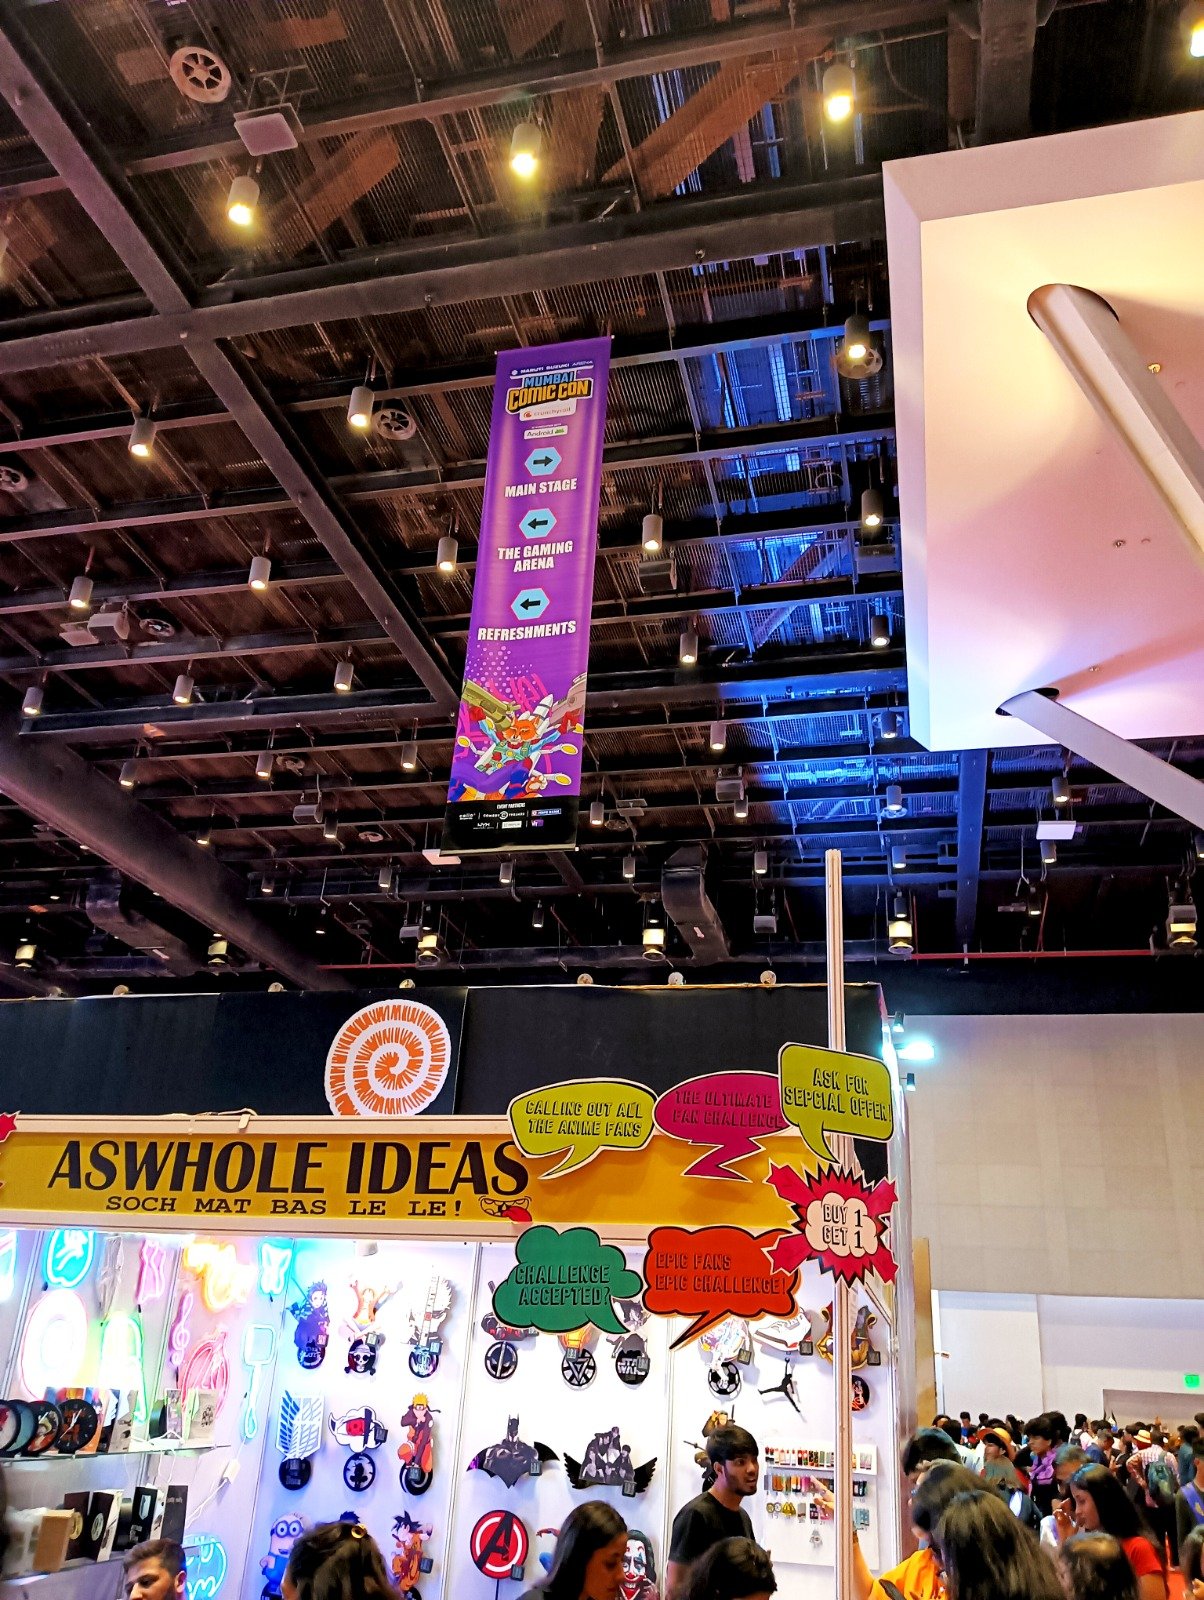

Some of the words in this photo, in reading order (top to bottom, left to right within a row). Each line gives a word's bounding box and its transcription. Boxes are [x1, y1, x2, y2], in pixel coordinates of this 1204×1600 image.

[524, 371, 575, 388] MUMBAI
[508, 384, 557, 411] COMIC
[557, 380, 591, 400] CON
[526, 429, 554, 438] Android
[504, 481, 537, 498] MAIN
[538, 478, 578, 494] STAGE
[497, 546, 521, 560] THE
[523, 541, 573, 558] GAMING
[513, 556, 555, 572] ARENA
[477, 620, 577, 641] REFRESHMENTS
[812, 1068, 840, 1089] ASK
[845, 1074, 869, 1096] FOR
[674, 1090, 700, 1105] THE
[704, 1091, 773, 1108] ULTIMATE
[784, 1086, 846, 1114] SEPCIAL
[850, 1097, 893, 1122] OFFER!
[525, 1100, 583, 1116] CALLING
[586, 1102, 613, 1117] OUT
[616, 1103, 644, 1119] ALL
[672, 1110, 700, 1124] FAN
[703, 1111, 784, 1129] CHALLENGE
[528, 1118, 554, 1134] THE
[558, 1120, 601, 1136] ANIME
[605, 1121, 642, 1138] FANS
[47, 1140, 328, 1195] ASWHOLE
[345, 1141, 529, 1196] IDEAS
[106, 1196, 177, 1212] SOCH
[193, 1198, 252, 1213] MAT
[269, 1199, 327, 1215] BAS
[348, 1200, 387, 1216] LE
[407, 1200, 462, 1217] LE!
[822, 1204, 849, 1225] BUY
[854, 1209, 864, 1228] 1
[822, 1225, 849, 1246] GET
[854, 1230, 864, 1249] 1
[655, 1252, 688, 1269] EPIC
[693, 1254, 732, 1271] FANS
[515, 1264, 611, 1285] CHALLENGE
[655, 1275, 688, 1291] EPIC
[693, 1275, 787, 1295] CHALLENGE!
[518, 1286, 611, 1306] ACCEPTED?
